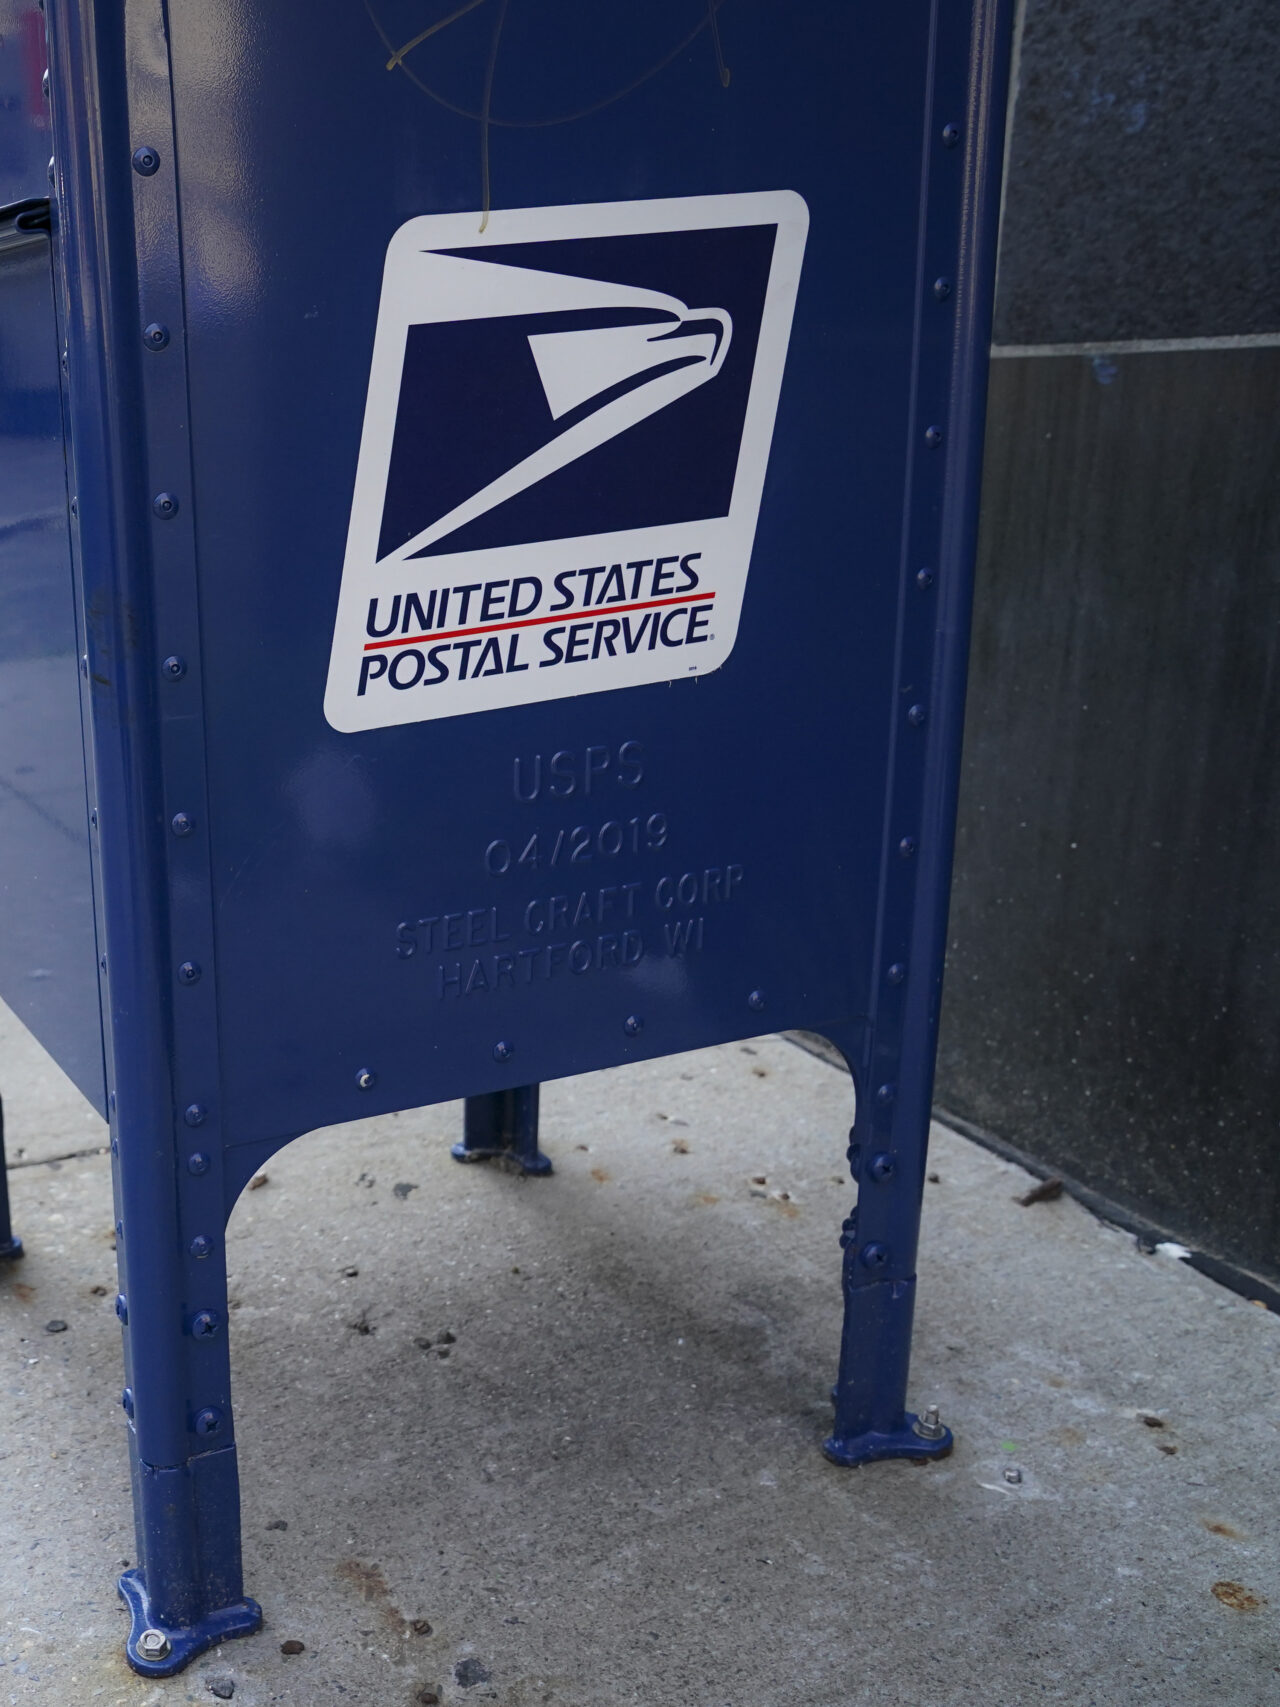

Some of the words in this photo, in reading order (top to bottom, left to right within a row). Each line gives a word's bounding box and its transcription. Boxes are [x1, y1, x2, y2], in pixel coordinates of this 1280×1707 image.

[365, 576, 542, 638] UNITED
[550, 552, 702, 611] STATES
[357, 634, 529, 696] POSTAL
[513, 740, 645, 800] USPS
[484, 812, 668, 875] 04/2019
[396, 907, 511, 959] STEEL
[524, 882, 642, 935] CRAFT
[656, 864, 744, 911] CORP
[438, 930, 643, 1000] HARTFORD
[664, 917, 705, 959] WI
